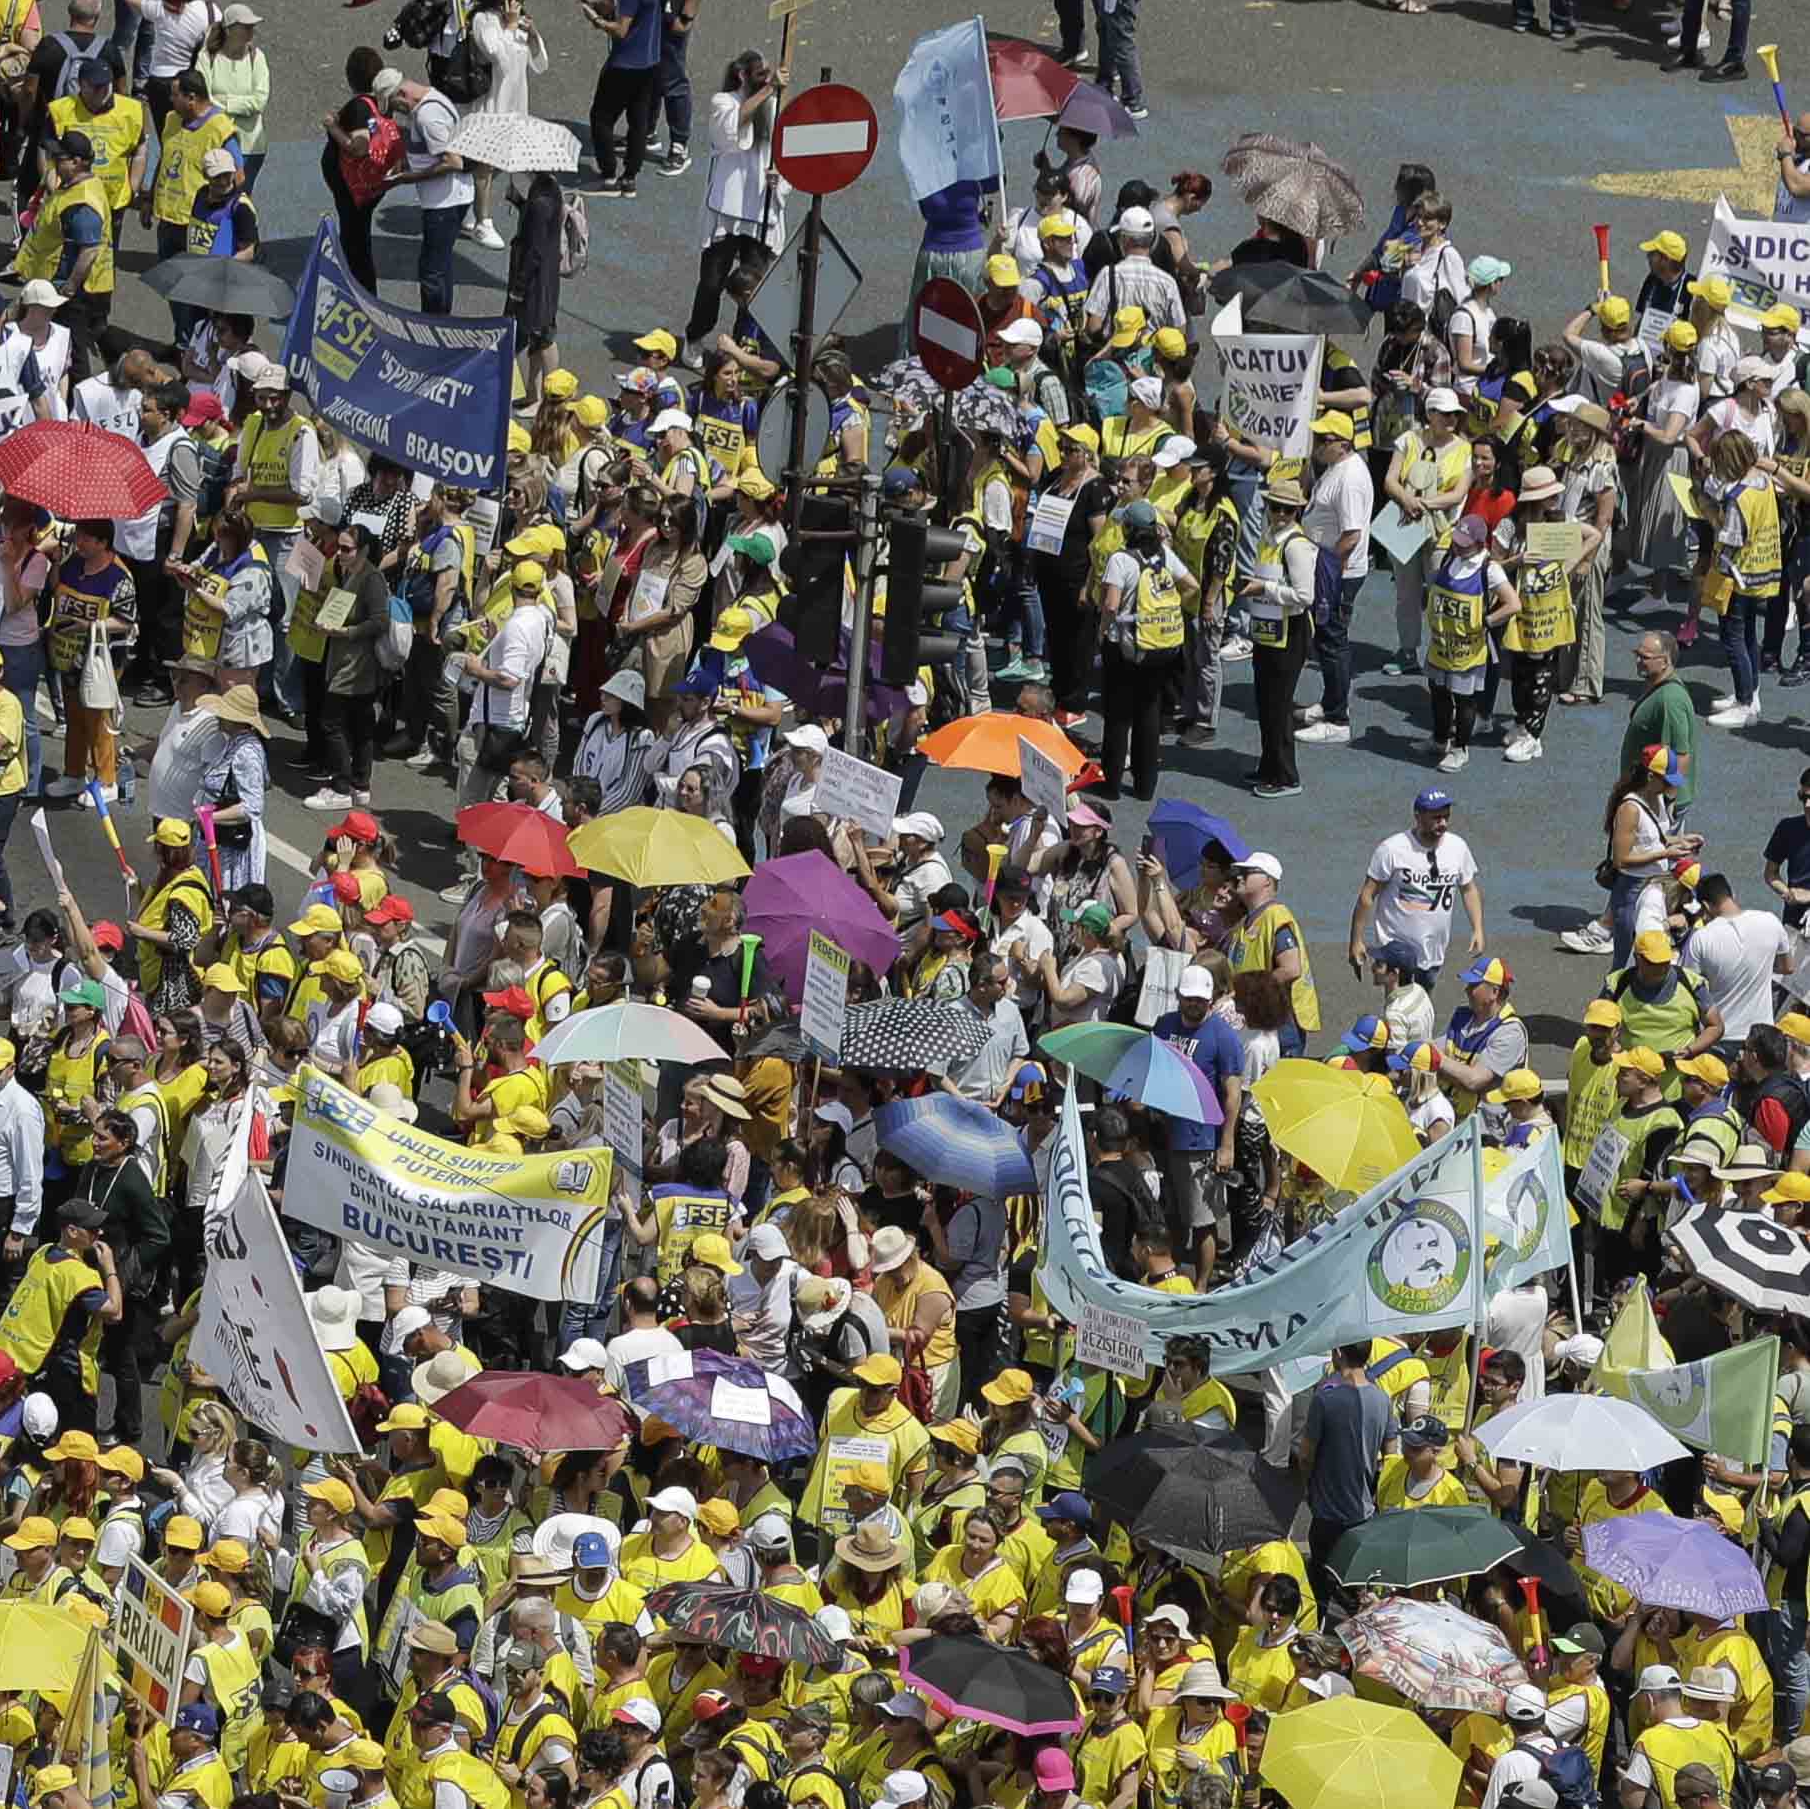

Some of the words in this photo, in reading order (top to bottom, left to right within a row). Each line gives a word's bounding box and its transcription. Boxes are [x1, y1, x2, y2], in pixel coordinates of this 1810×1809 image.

[320, 302, 377, 355] FSE
[705, 424, 740, 449] FSE
[1426, 885, 1454, 910] 76
[318, 1083, 375, 1135] FSE
[313, 1140, 412, 1204] SINDICATUL
[349, 1181, 377, 1210] DIN
[342, 1201, 534, 1280] BUCUREȘTI
[687, 1206, 727, 1227] FSE
[119, 1602, 177, 1684] BRĂILA
